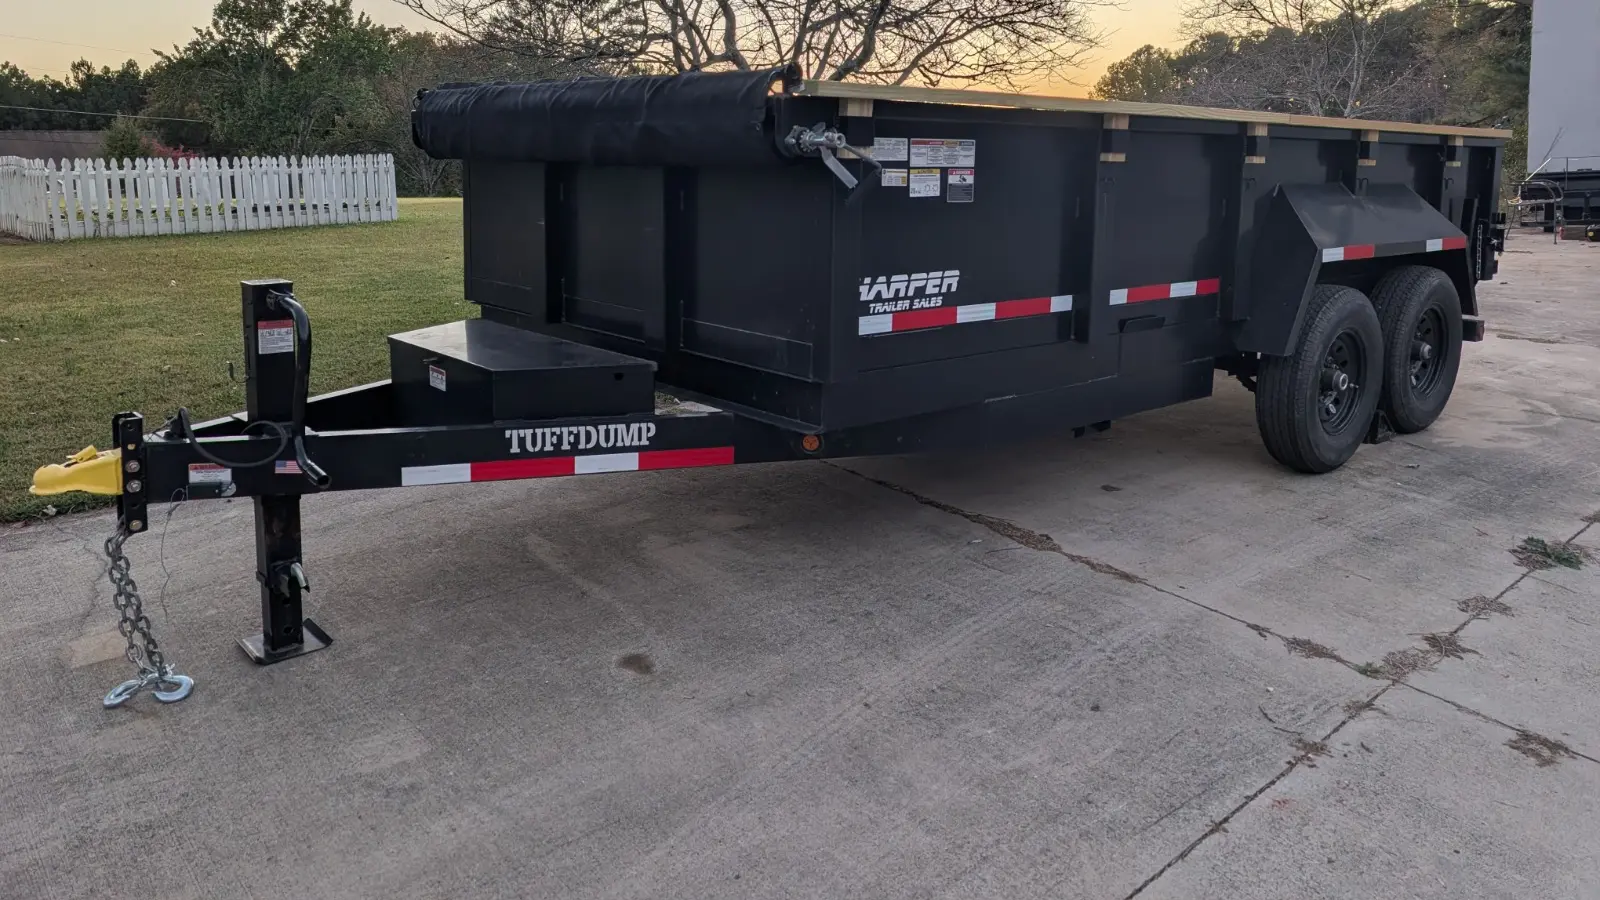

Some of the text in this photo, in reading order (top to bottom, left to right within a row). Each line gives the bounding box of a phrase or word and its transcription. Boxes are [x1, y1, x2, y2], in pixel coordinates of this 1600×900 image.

[869, 296, 943, 314] TRAILER SALES
[505, 422, 656, 453] TUFFDUMP
